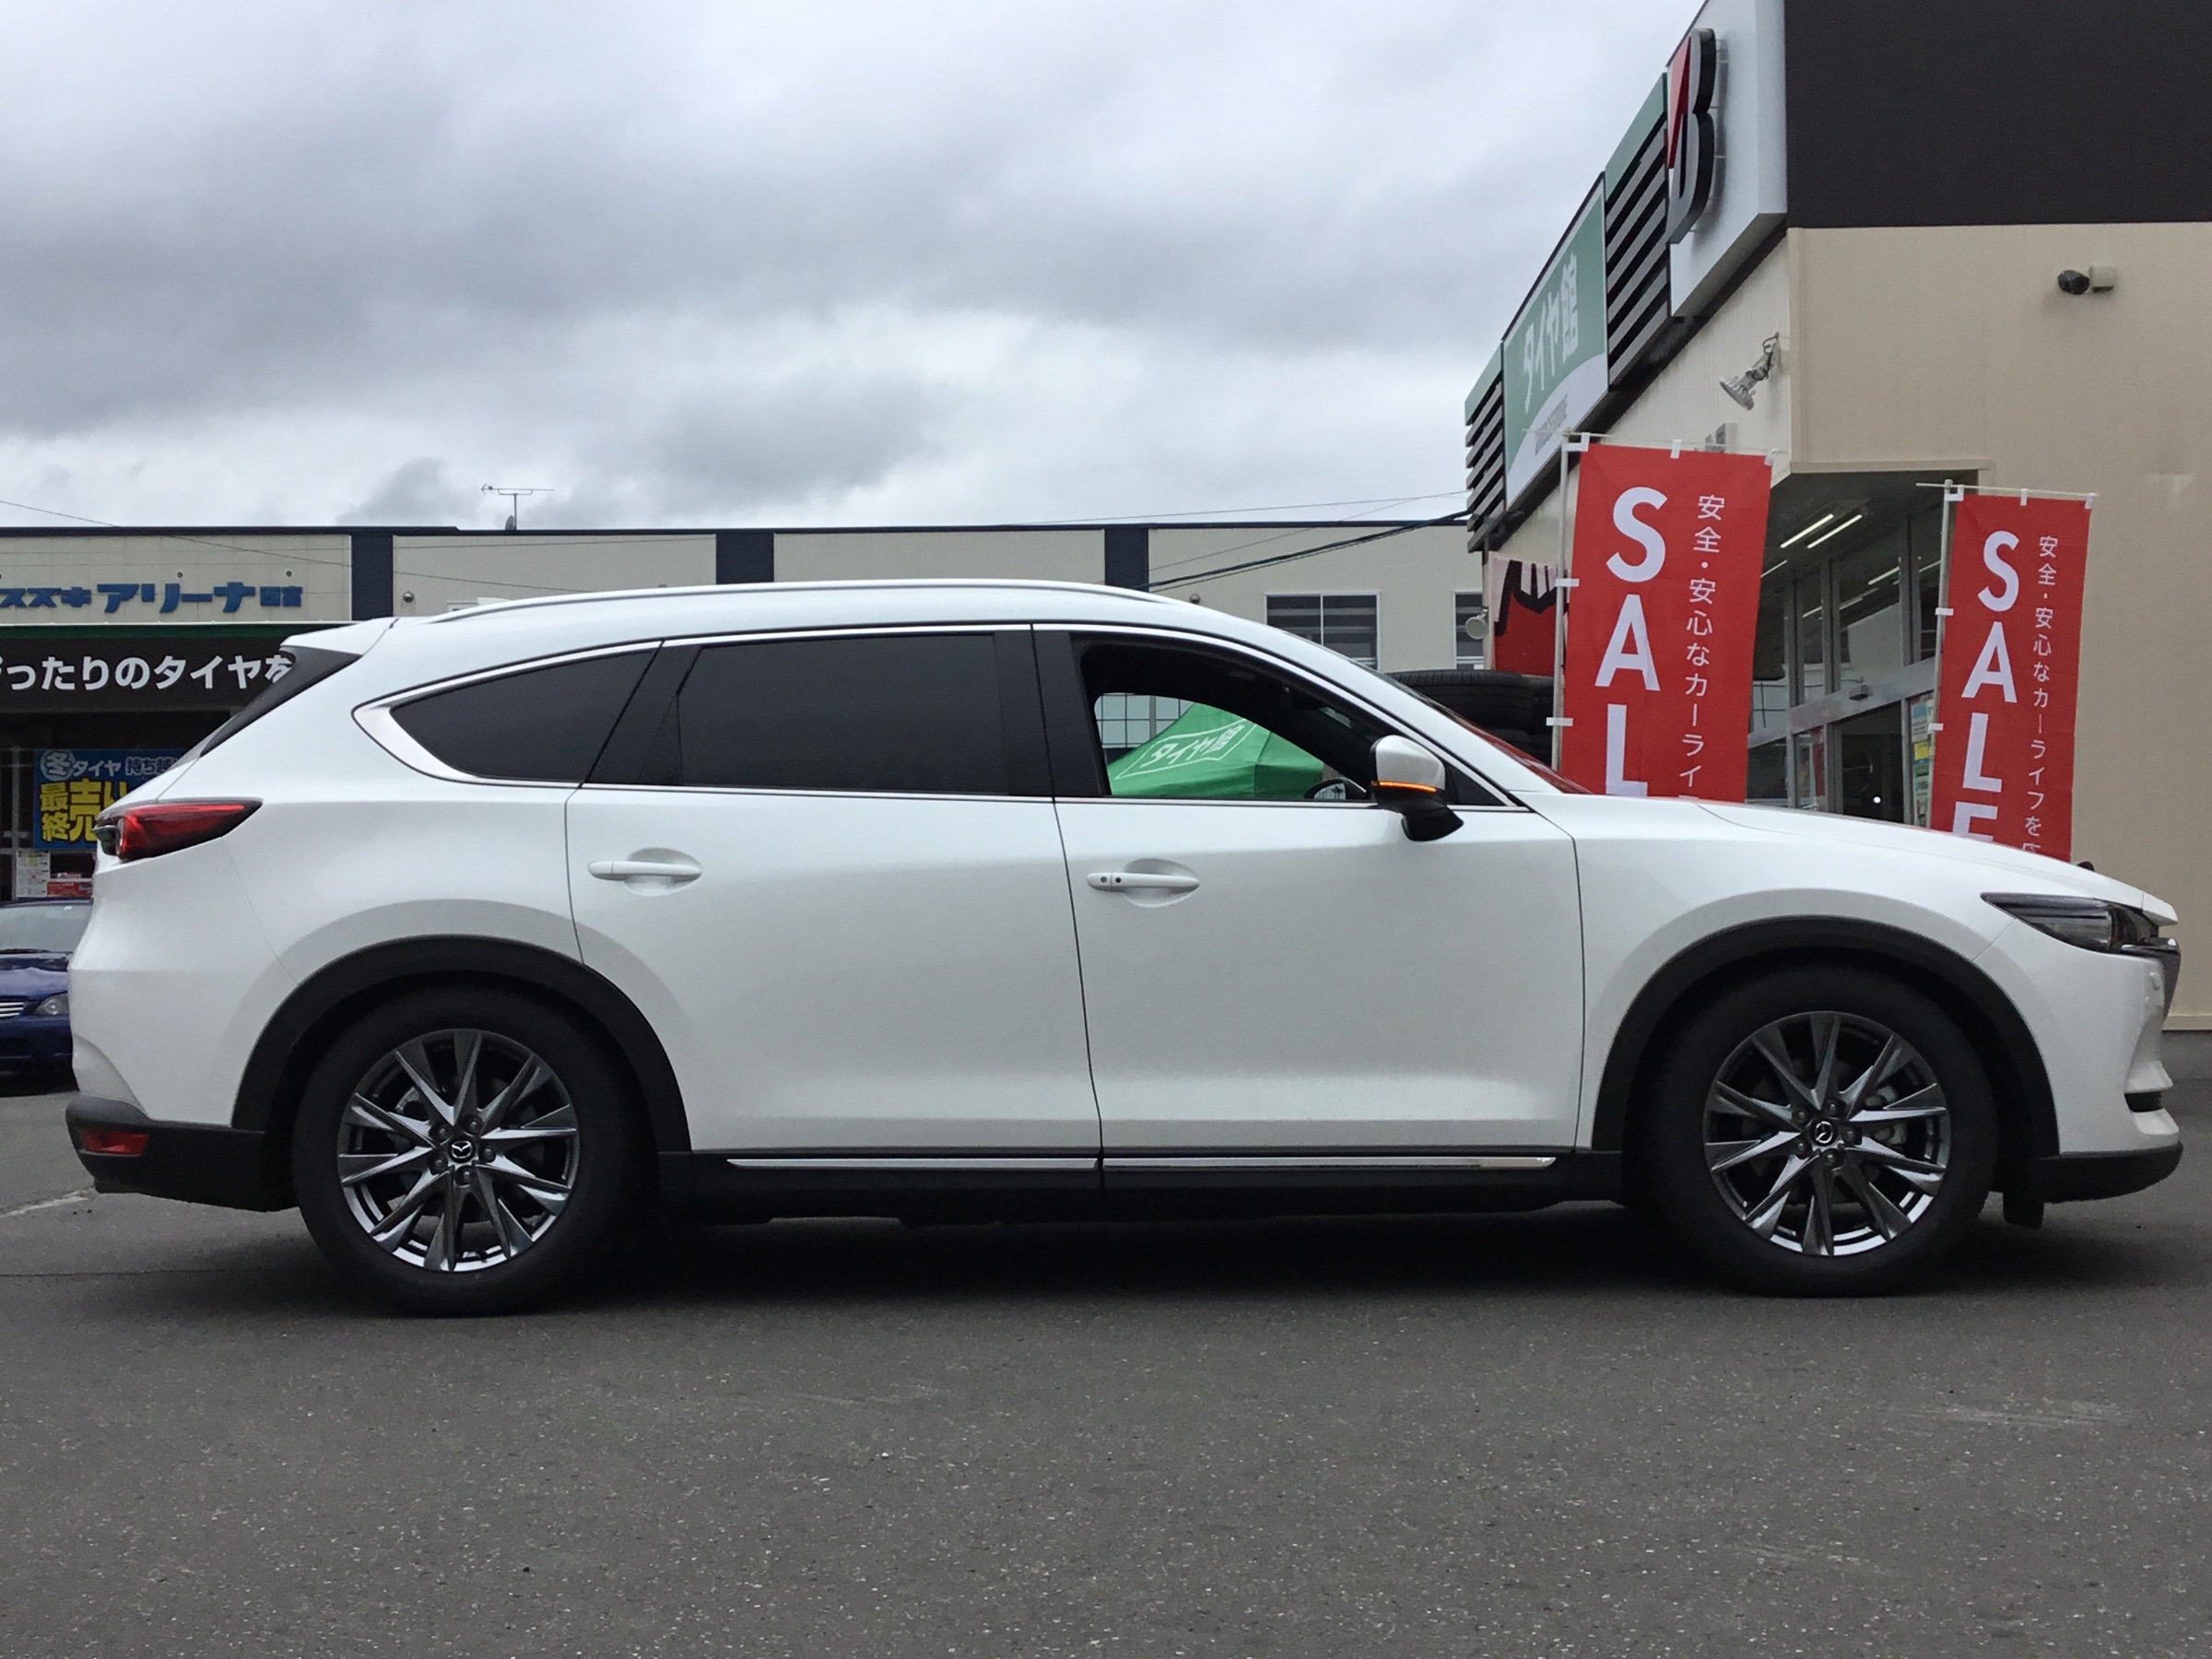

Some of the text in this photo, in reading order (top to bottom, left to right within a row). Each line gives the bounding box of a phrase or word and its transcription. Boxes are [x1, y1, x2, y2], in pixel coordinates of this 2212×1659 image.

[0, 655, 292, 689] ったりのタイヤを
[1678, 494, 1725, 800] 安全・安心なカーライ
